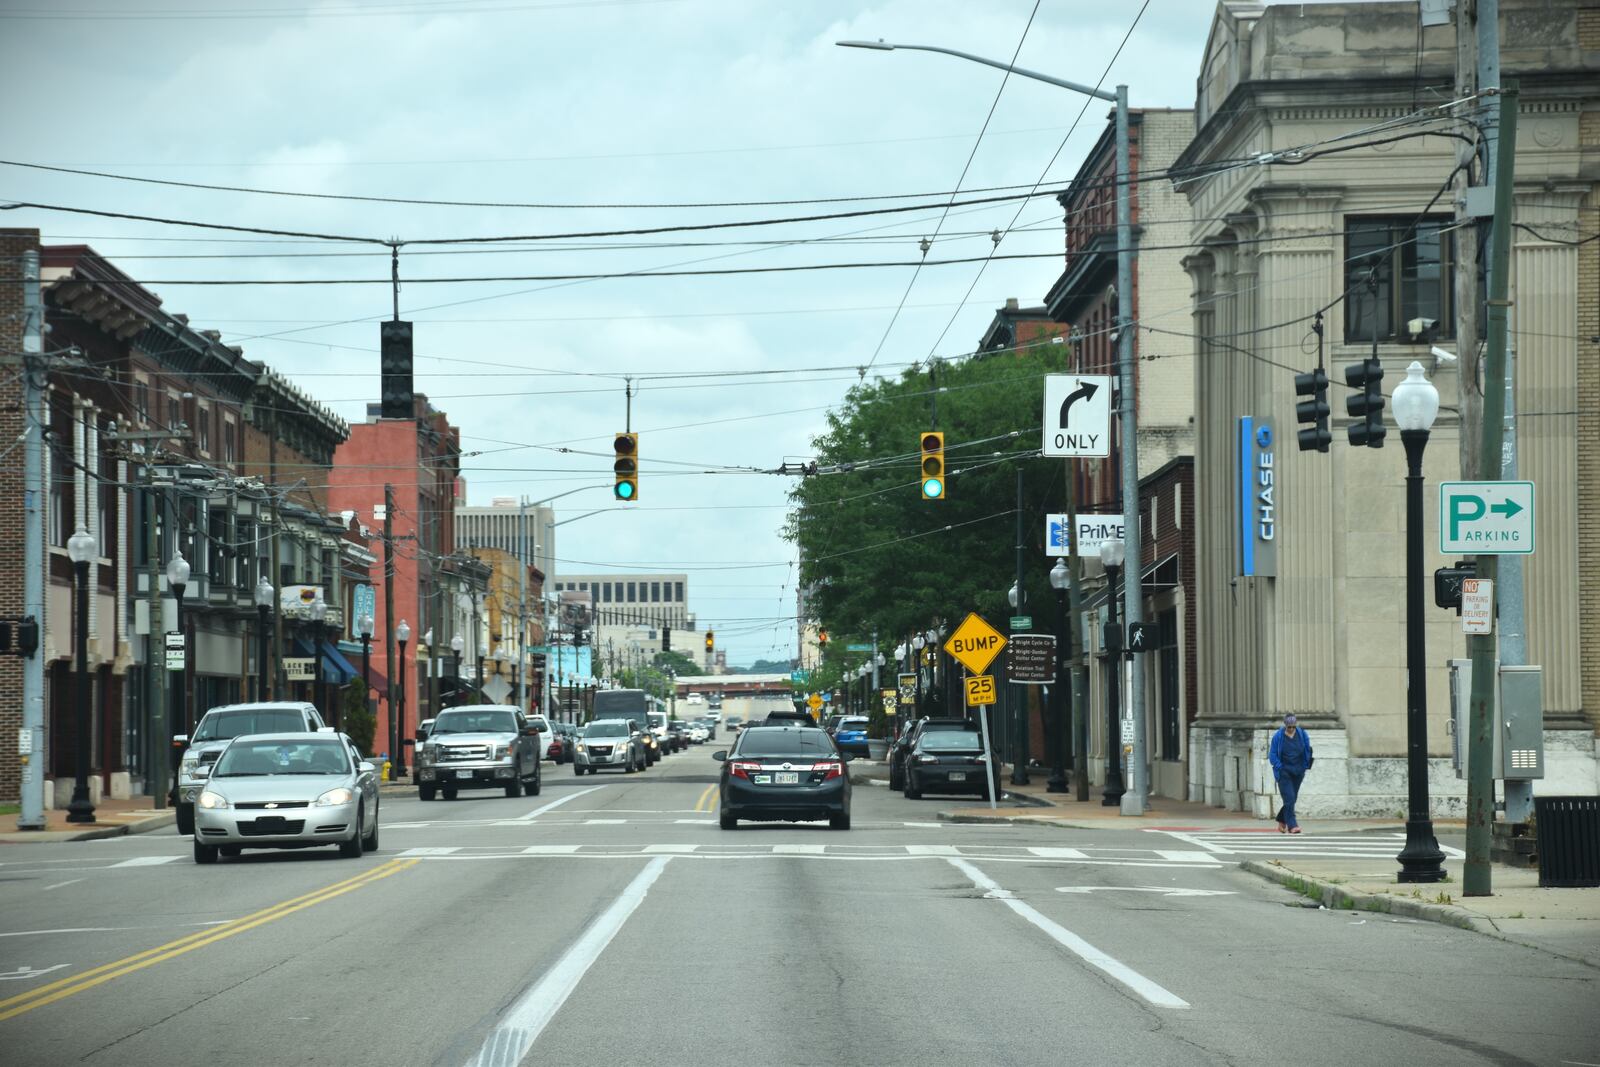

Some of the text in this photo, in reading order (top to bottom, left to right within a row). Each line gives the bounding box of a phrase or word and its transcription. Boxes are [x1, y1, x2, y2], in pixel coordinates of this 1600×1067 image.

[1055, 434, 1099, 449] ONLY
[1259, 452, 1274, 541] CHASE
[1080, 524, 1124, 539] PriME
[1465, 581, 1478, 592] NO
[1465, 595, 1489, 603] PARKING
[953, 635, 998, 653] BUMP
[969, 679, 992, 694] 25
